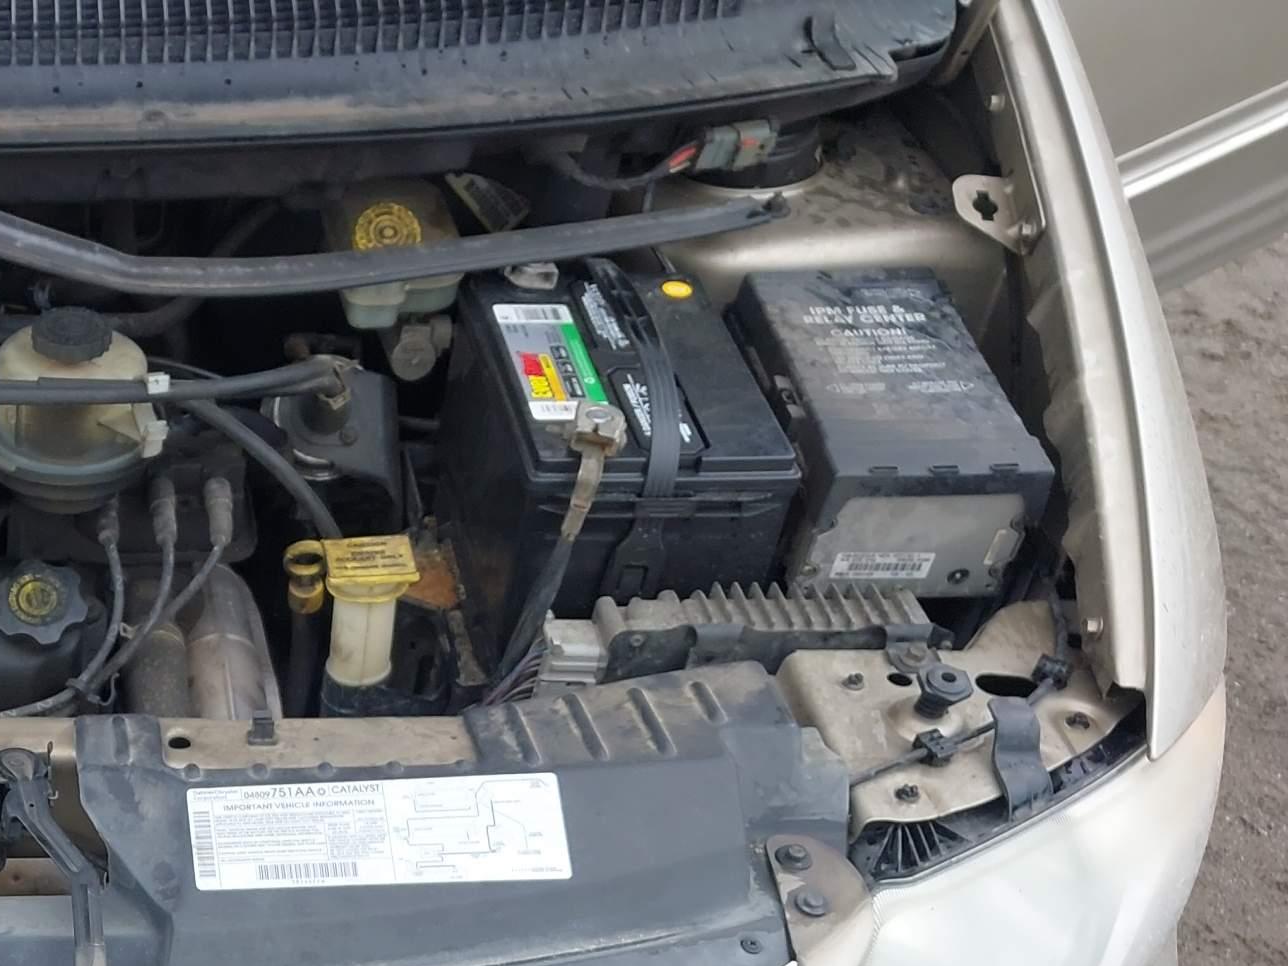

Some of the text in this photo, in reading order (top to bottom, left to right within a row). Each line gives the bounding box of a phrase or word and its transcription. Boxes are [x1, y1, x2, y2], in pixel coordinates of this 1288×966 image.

[809, 304, 906, 316] IPM FUSE &
[803, 311, 928, 325] RELAY CENTER
[830, 326, 908, 338] CAUTION!
[331, 783, 380, 795] CATALYST
[223, 798, 375, 812] IMPORTANT VEHICLE INFORMATION
